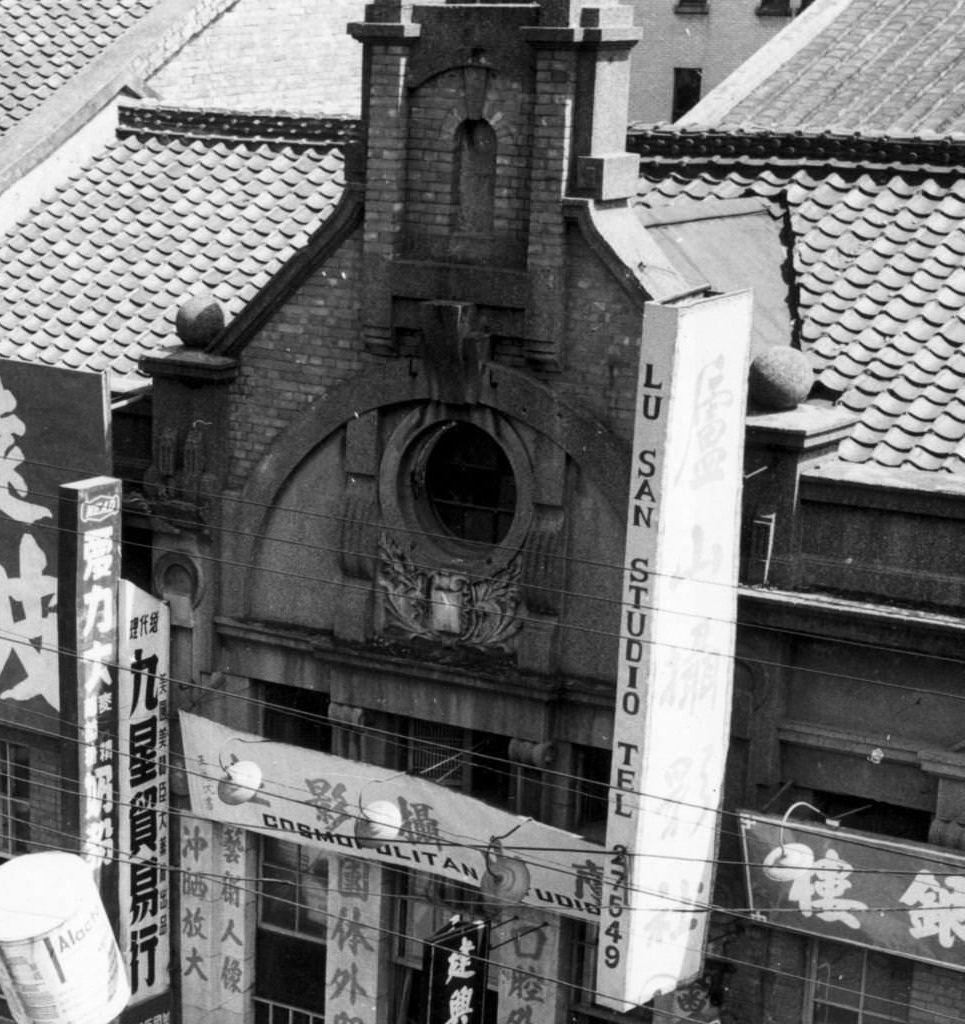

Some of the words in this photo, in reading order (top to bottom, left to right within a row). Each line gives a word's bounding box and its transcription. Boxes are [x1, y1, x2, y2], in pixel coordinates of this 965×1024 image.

[642, 363, 663, 420] LU
[634, 450, 657, 528] SAN
[621, 557, 649, 715] STUDIO
[614, 741, 638, 818] TEL
[263, 812, 480, 881] COSMOOLITAN
[524, 886, 602, 917] UDIO
